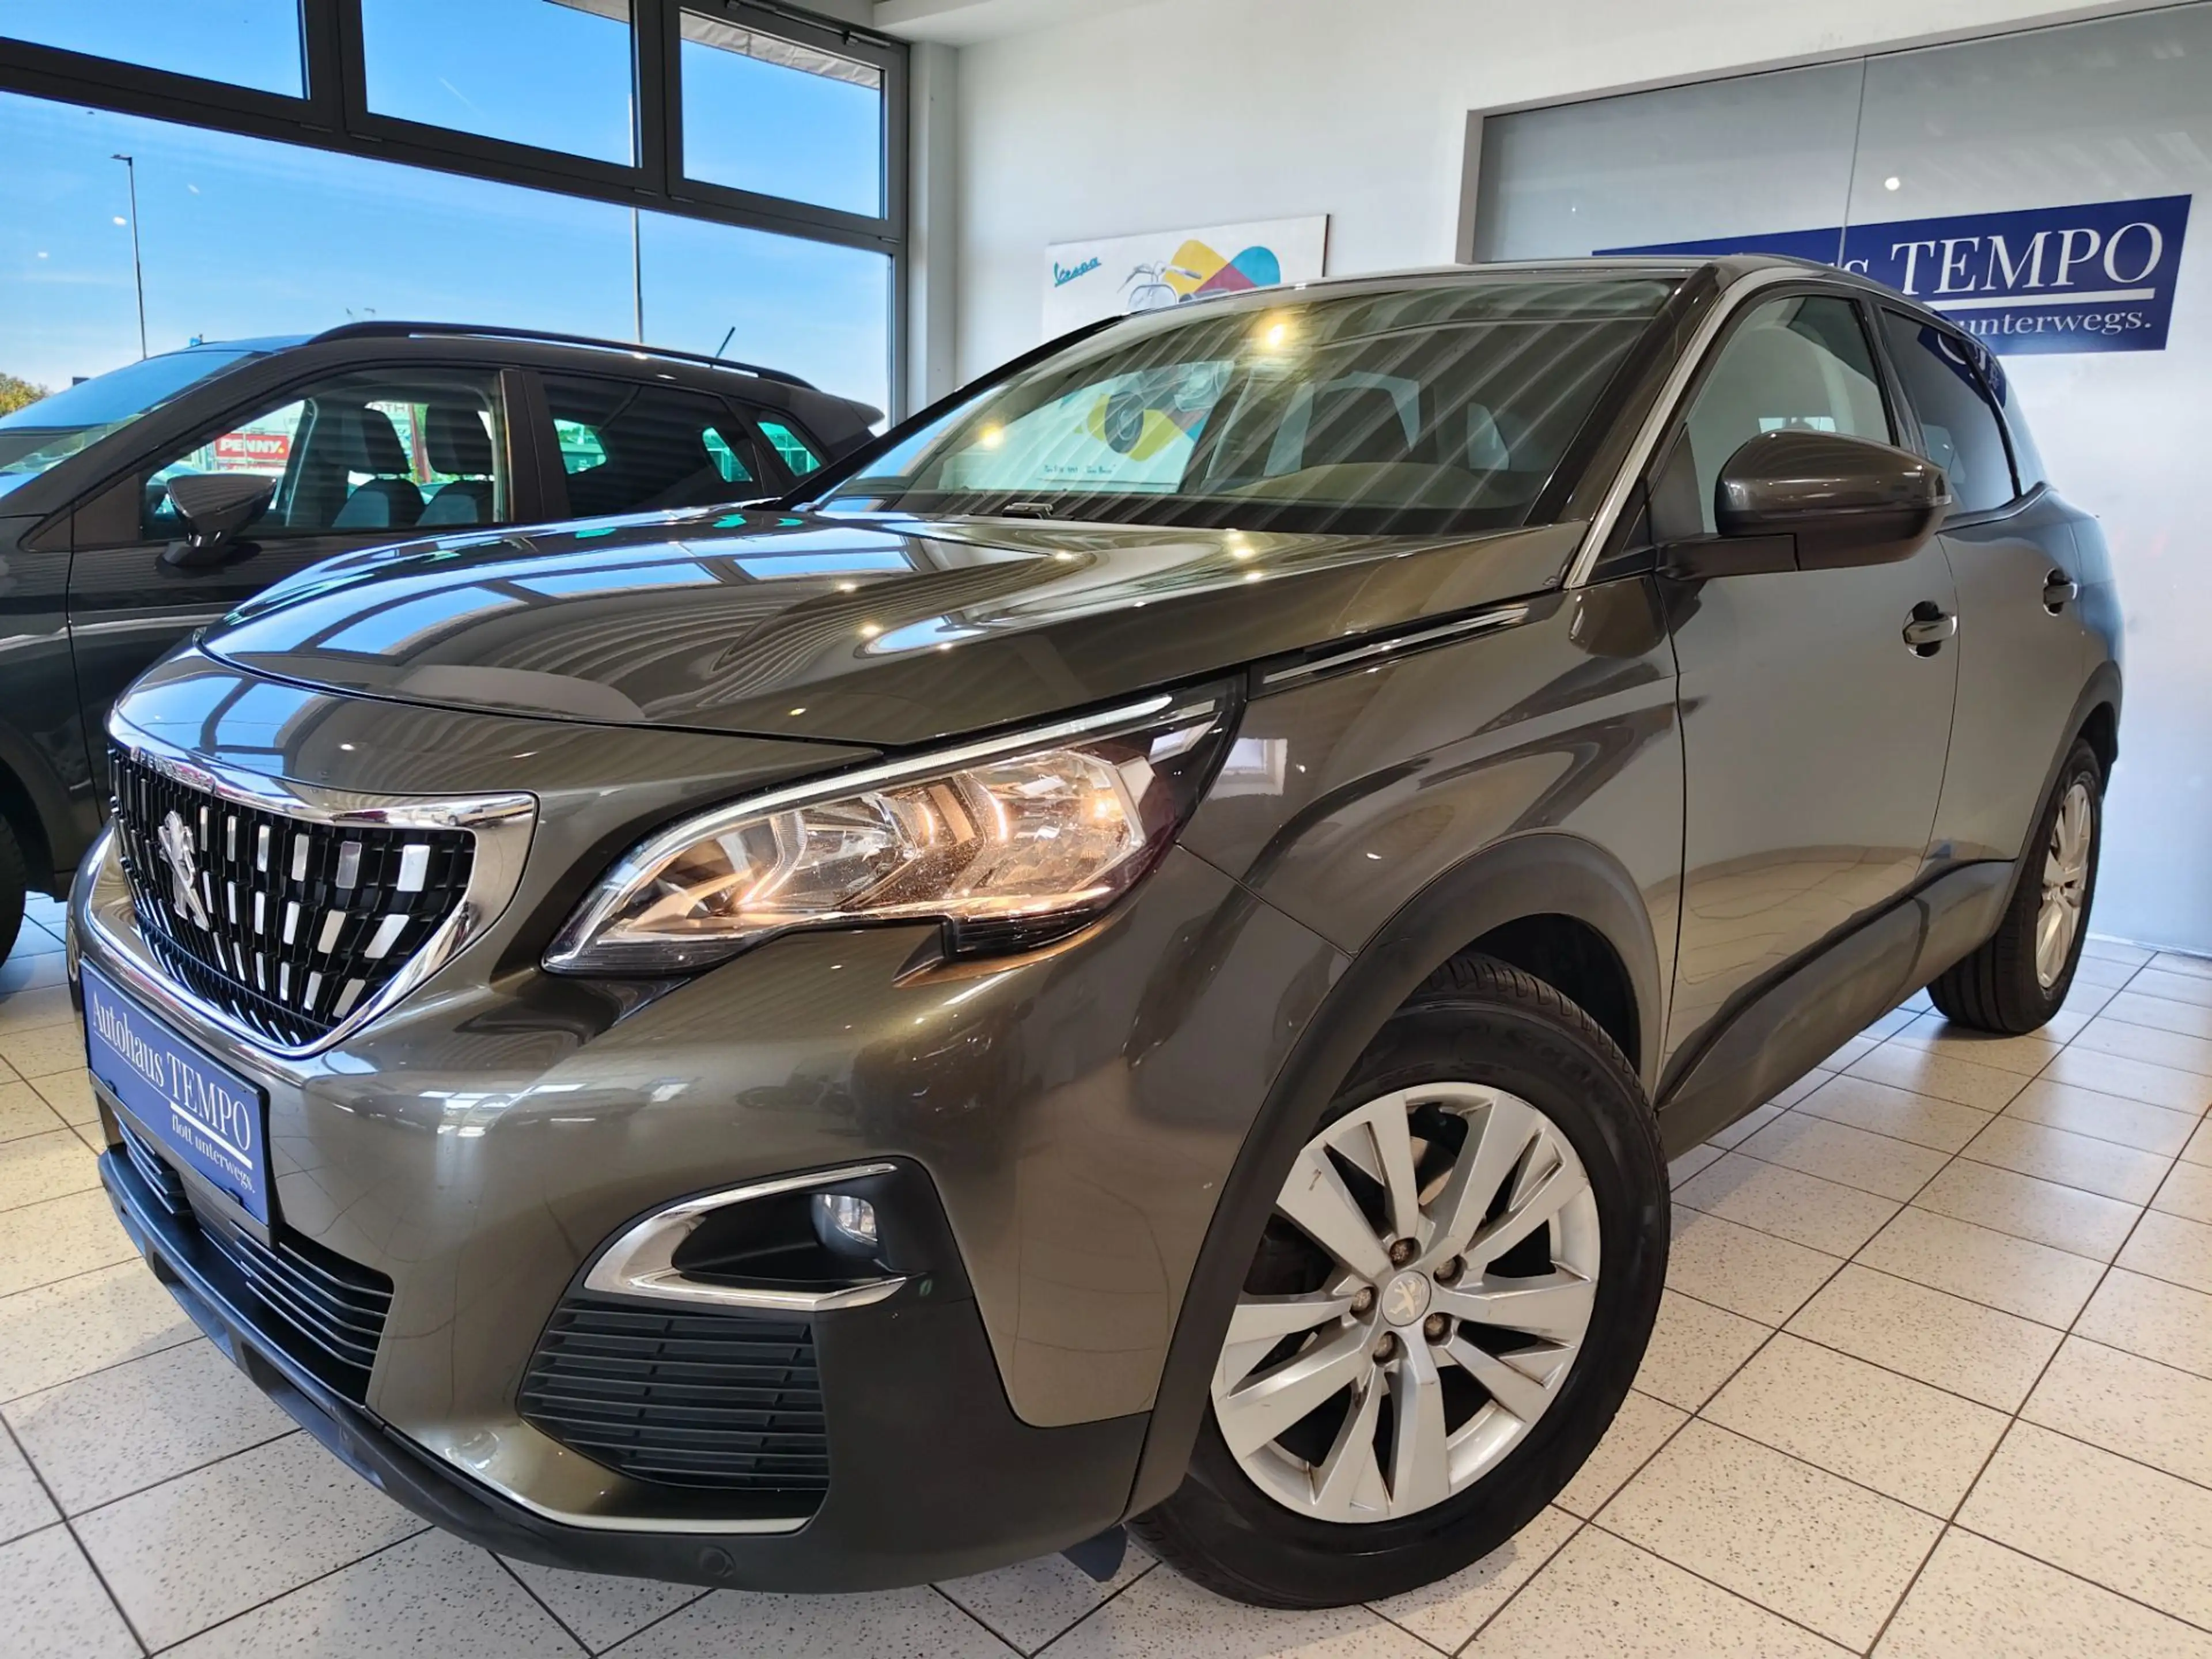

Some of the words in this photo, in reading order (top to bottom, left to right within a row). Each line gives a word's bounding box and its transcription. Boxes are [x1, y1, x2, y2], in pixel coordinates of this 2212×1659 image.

[1054, 257, 1101, 288] Vespa
[1890, 222, 2163, 296] TEMPO
[93, 991, 165, 1088] Autohaus
[166, 1051, 251, 1151] TEMPO
[172, 1113, 194, 1145] flott
[195, 1135, 256, 1194] unterwegs.
